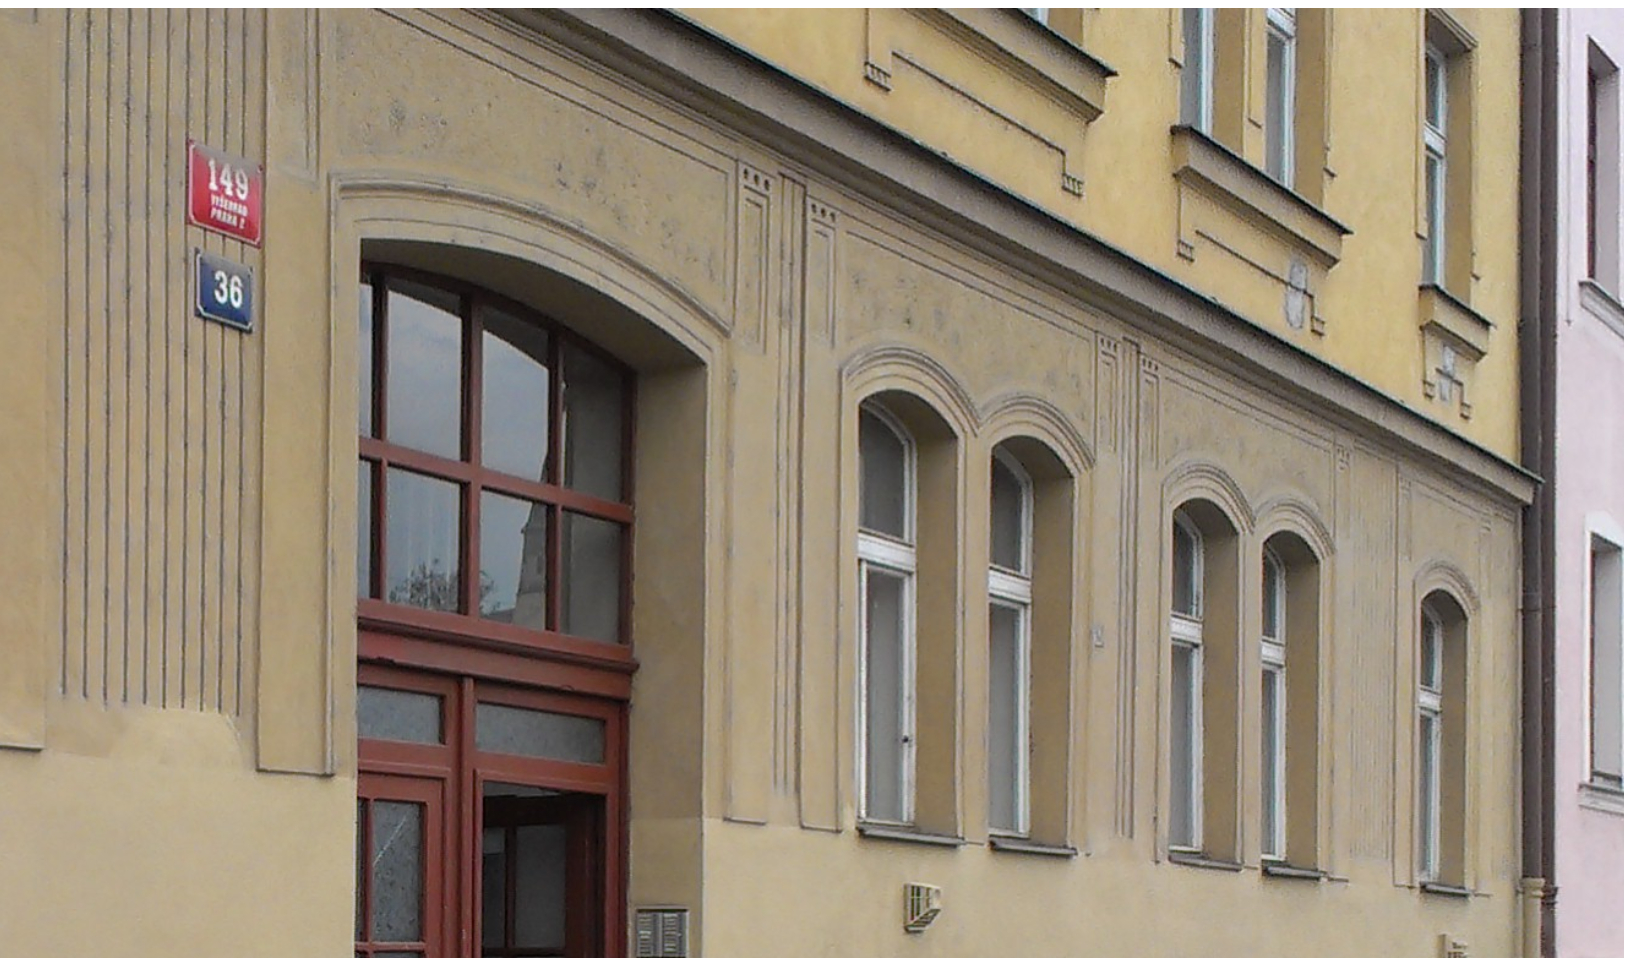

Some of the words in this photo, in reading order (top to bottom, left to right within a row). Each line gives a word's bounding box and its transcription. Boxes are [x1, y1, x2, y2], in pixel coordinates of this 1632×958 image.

[209, 158, 249, 201] 149
[210, 207, 238, 227] PRAHA
[214, 271, 243, 308] 36
